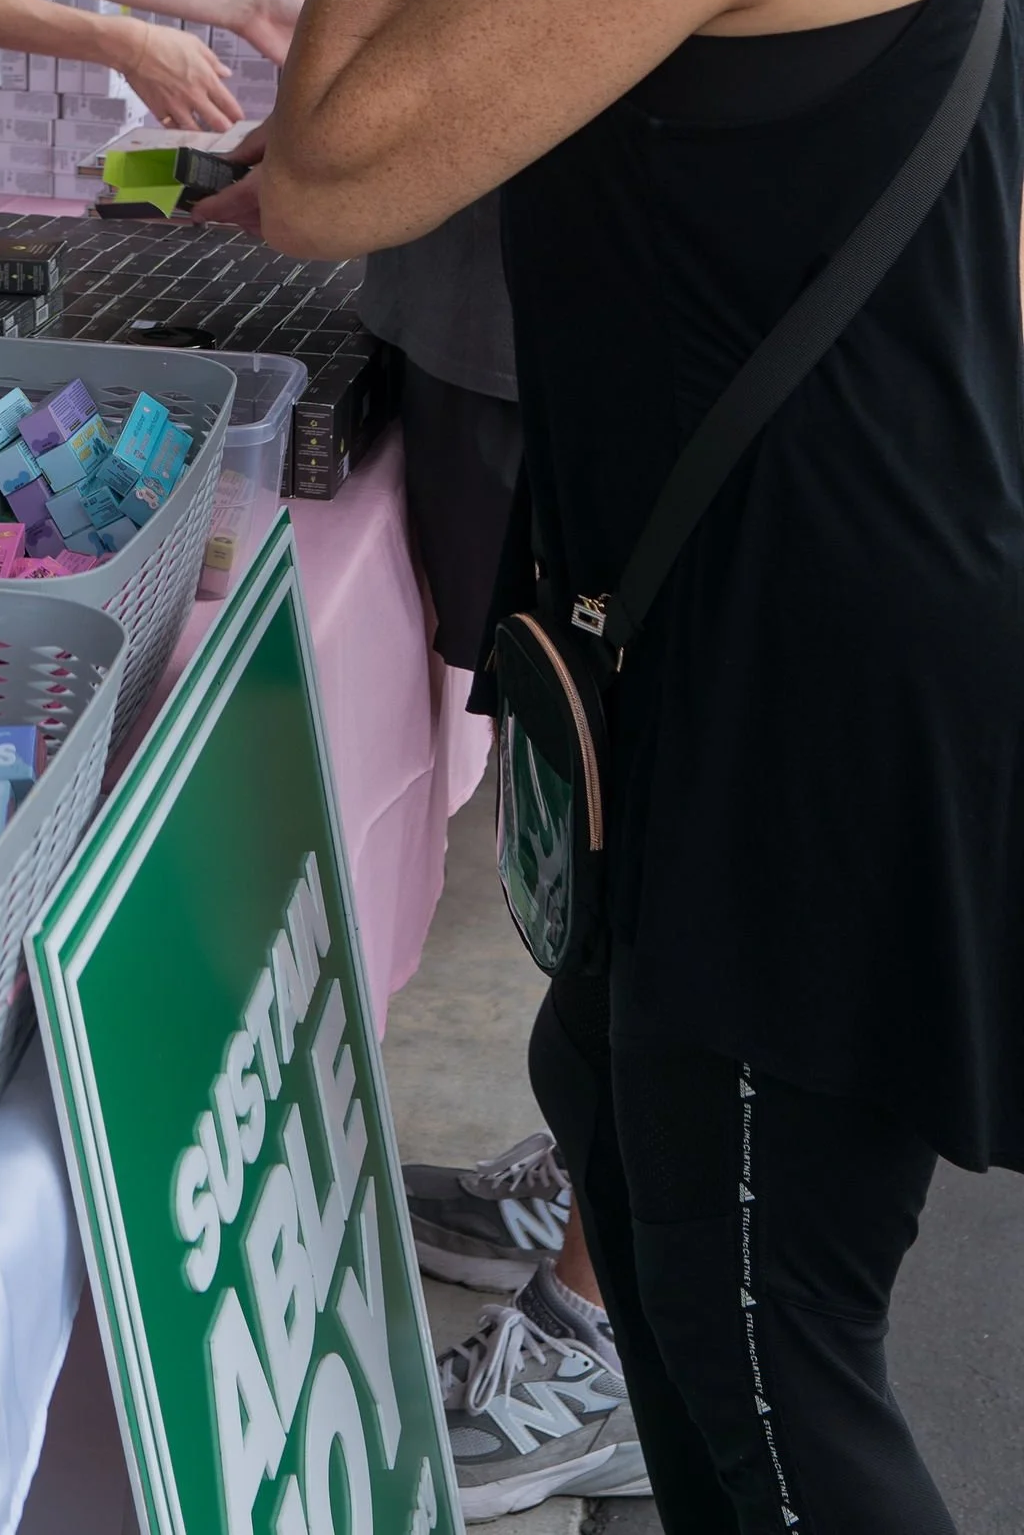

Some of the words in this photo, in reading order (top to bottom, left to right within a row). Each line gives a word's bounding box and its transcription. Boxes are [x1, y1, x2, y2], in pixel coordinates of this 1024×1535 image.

[176, 851, 331, 1293] SUSTAIN
[209, 977, 369, 1535] ABLE
[487, 1382, 583, 1456] N
